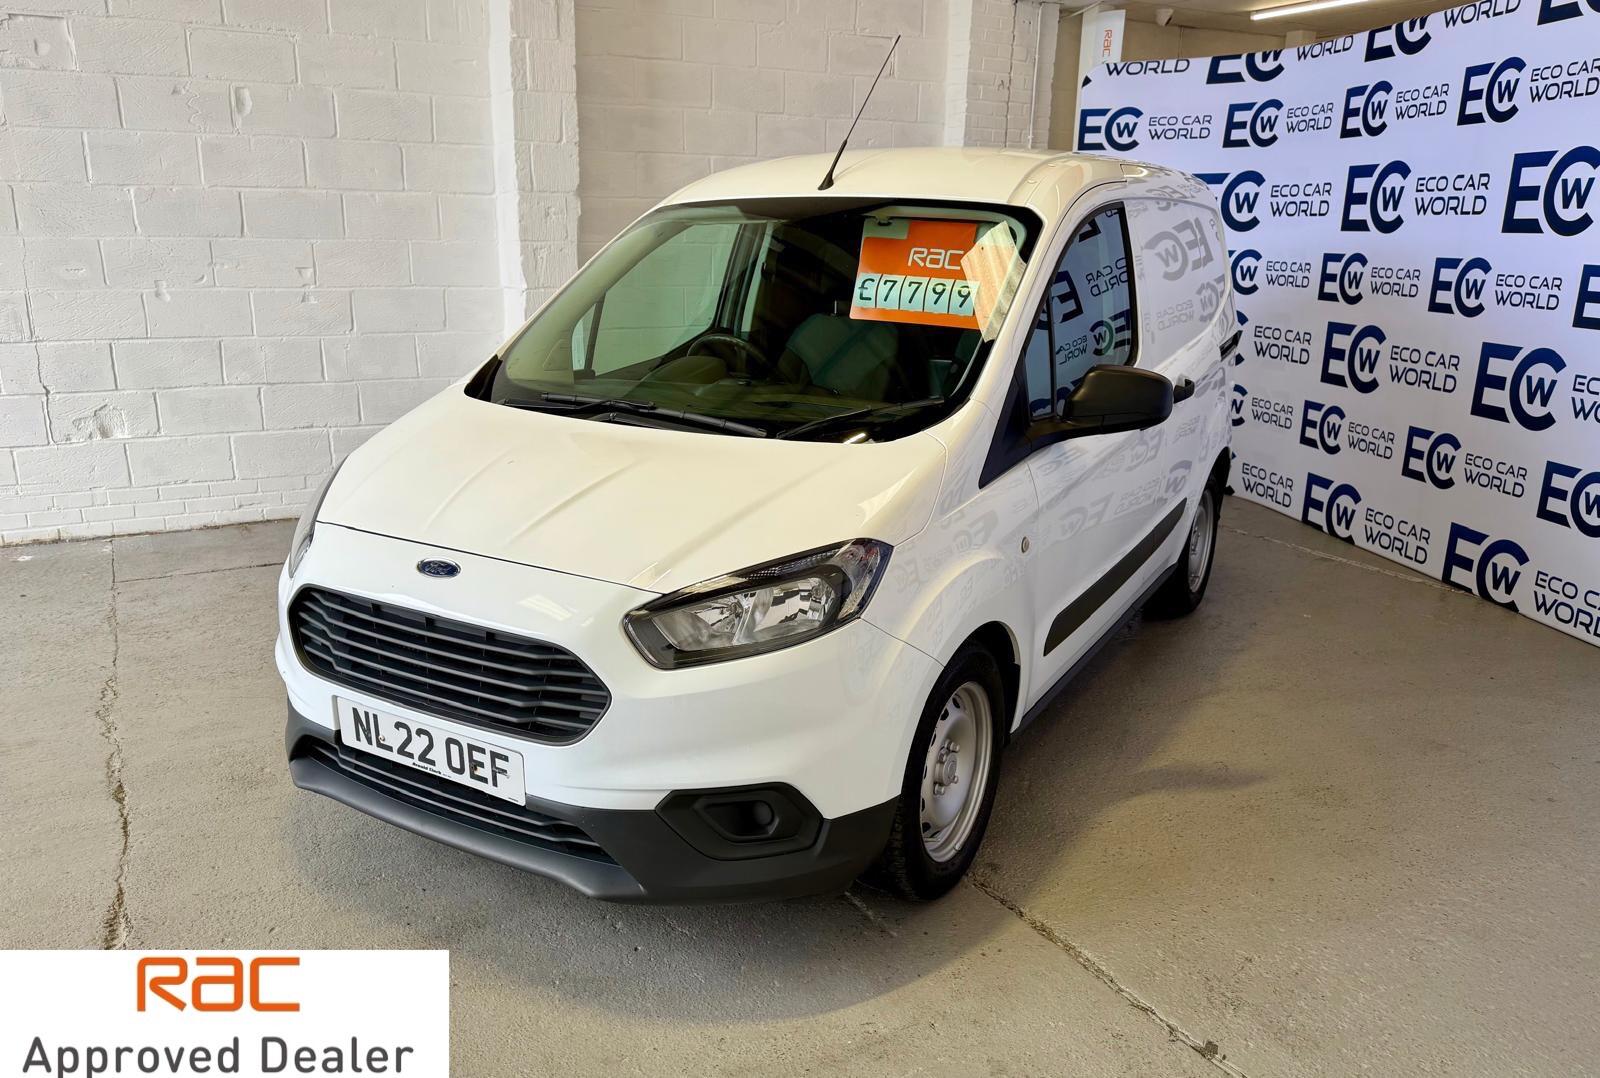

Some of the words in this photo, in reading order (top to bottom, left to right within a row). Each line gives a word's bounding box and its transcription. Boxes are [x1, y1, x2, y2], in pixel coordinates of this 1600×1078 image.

[1444, 0, 1521, 29] WORLD
[1297, 35, 1354, 61] WORLD
[1105, 58, 1190, 76] WORLD
[1530, 64, 1563, 83] ECO
[1566, 57, 1600, 77] CAR
[1396, 88, 1419, 104] ECO
[1422, 83, 1449, 99] CAR
[1529, 76, 1600, 103] WORLD
[1148, 115, 1178, 126] ECO
[1181, 114, 1212, 126] CAR
[1286, 105, 1310, 118] ECO
[1311, 102, 1334, 116] CAR
[1395, 100, 1447, 121] WORLD
[1148, 127, 1211, 140] WORLD
[1286, 116, 1332, 134] WORLD
[1270, 184, 1300, 198] ECO
[1303, 182, 1332, 197] CAR
[1415, 176, 1448, 193] ECO
[1452, 172, 1491, 191] CAR
[1270, 200, 1330, 217] WORLD
[1414, 196, 1487, 216] WORLD
[1266, 260, 1288, 272] ECO
[1289, 262, 1312, 274] CAR
[1370, 266, 1393, 279] ECO
[1395, 268, 1421, 281] CAR
[1266, 274, 1310, 288] WORLD
[1370, 281, 1418, 298] WORLD
[1495, 274, 1526, 288] ECO
[1529, 275, 1562, 291] CAR
[858, 278, 971, 308] £7799
[1494, 289, 1560, 311] WORLD
[1254, 325, 1282, 338] ECO
[1284, 329, 1312, 345] CAR
[1254, 341, 1310, 365] WORLD
[1390, 345, 1421, 364] ECO
[1425, 350, 1460, 371] CAR
[1389, 364, 1457, 393] WORLD
[1251, 397, 1272, 410] ECO
[1273, 402, 1294, 416] CAR
[1251, 409, 1292, 430] WORLD
[1348, 421, 1370, 436] ECO
[1371, 428, 1395, 445] CAR
[1347, 434, 1393, 460] WORLD
[1242, 463, 1267, 481] ECO
[1269, 471, 1294, 491] CAR
[1464, 452, 1493, 471] ECO
[1496, 460, 1528, 481] CAR
[1241, 477, 1292, 508] WORLD
[1464, 468, 1525, 498] WORLD
[1365, 507, 1394, 530] ECO
[1397, 519, 1431, 544] CAR
[1364, 525, 1428, 564] WORLD
[1535, 570, 1578, 600] ECO
[1534, 590, 1600, 637] WORL
[352, 707, 436, 767] NL22
[444, 736, 509, 788] OEF
